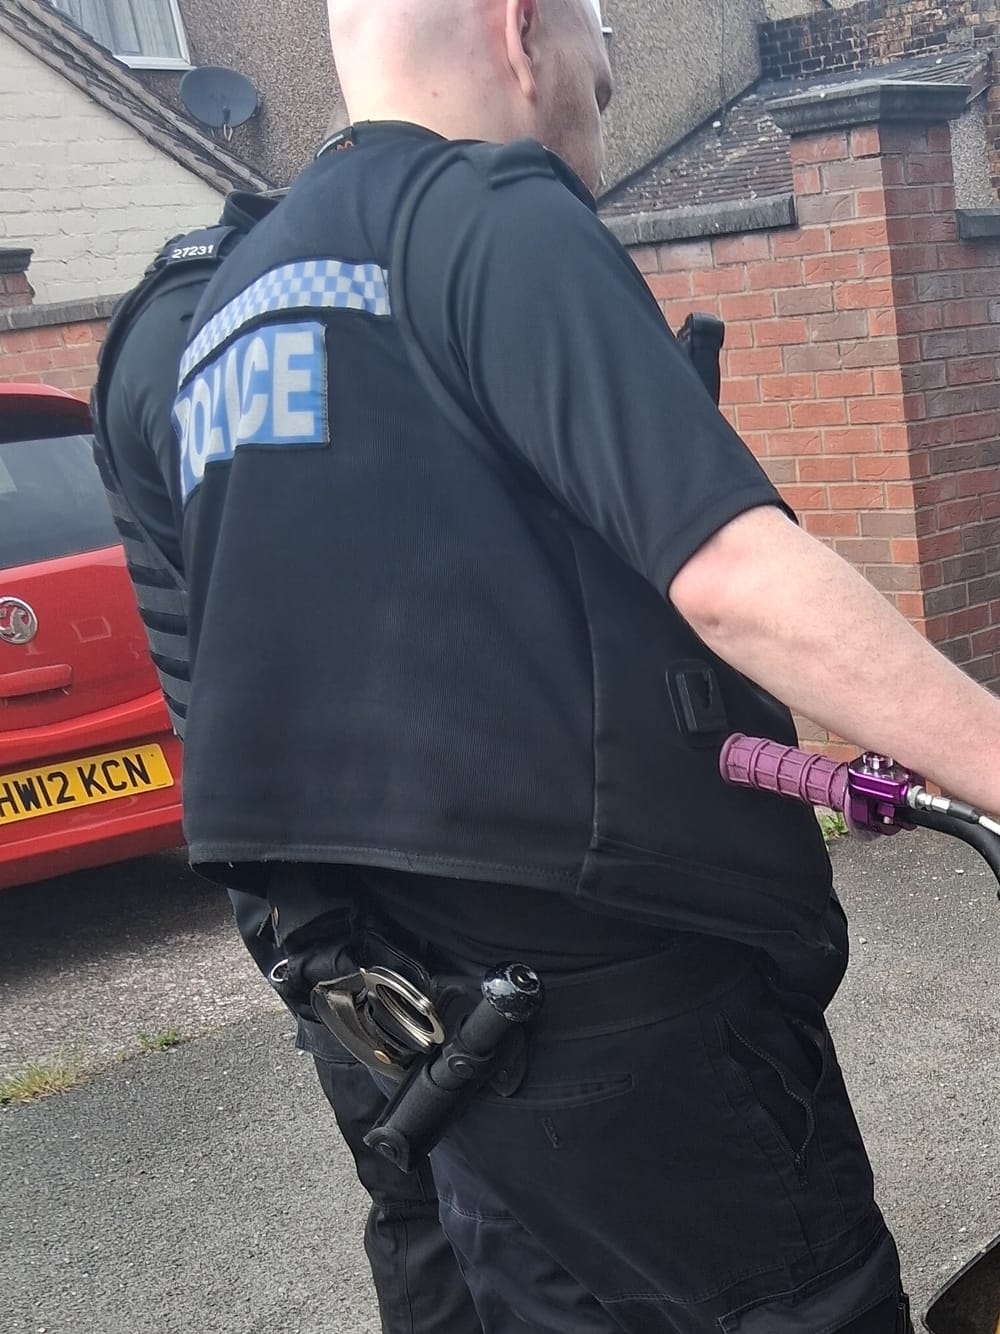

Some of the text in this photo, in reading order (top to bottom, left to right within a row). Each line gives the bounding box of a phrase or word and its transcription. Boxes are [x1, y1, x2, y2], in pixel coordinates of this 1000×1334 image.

[171, 244, 214, 259] 27231
[174, 330, 315, 492] POLICE
[0, 753, 151, 818] HW12 KCN
